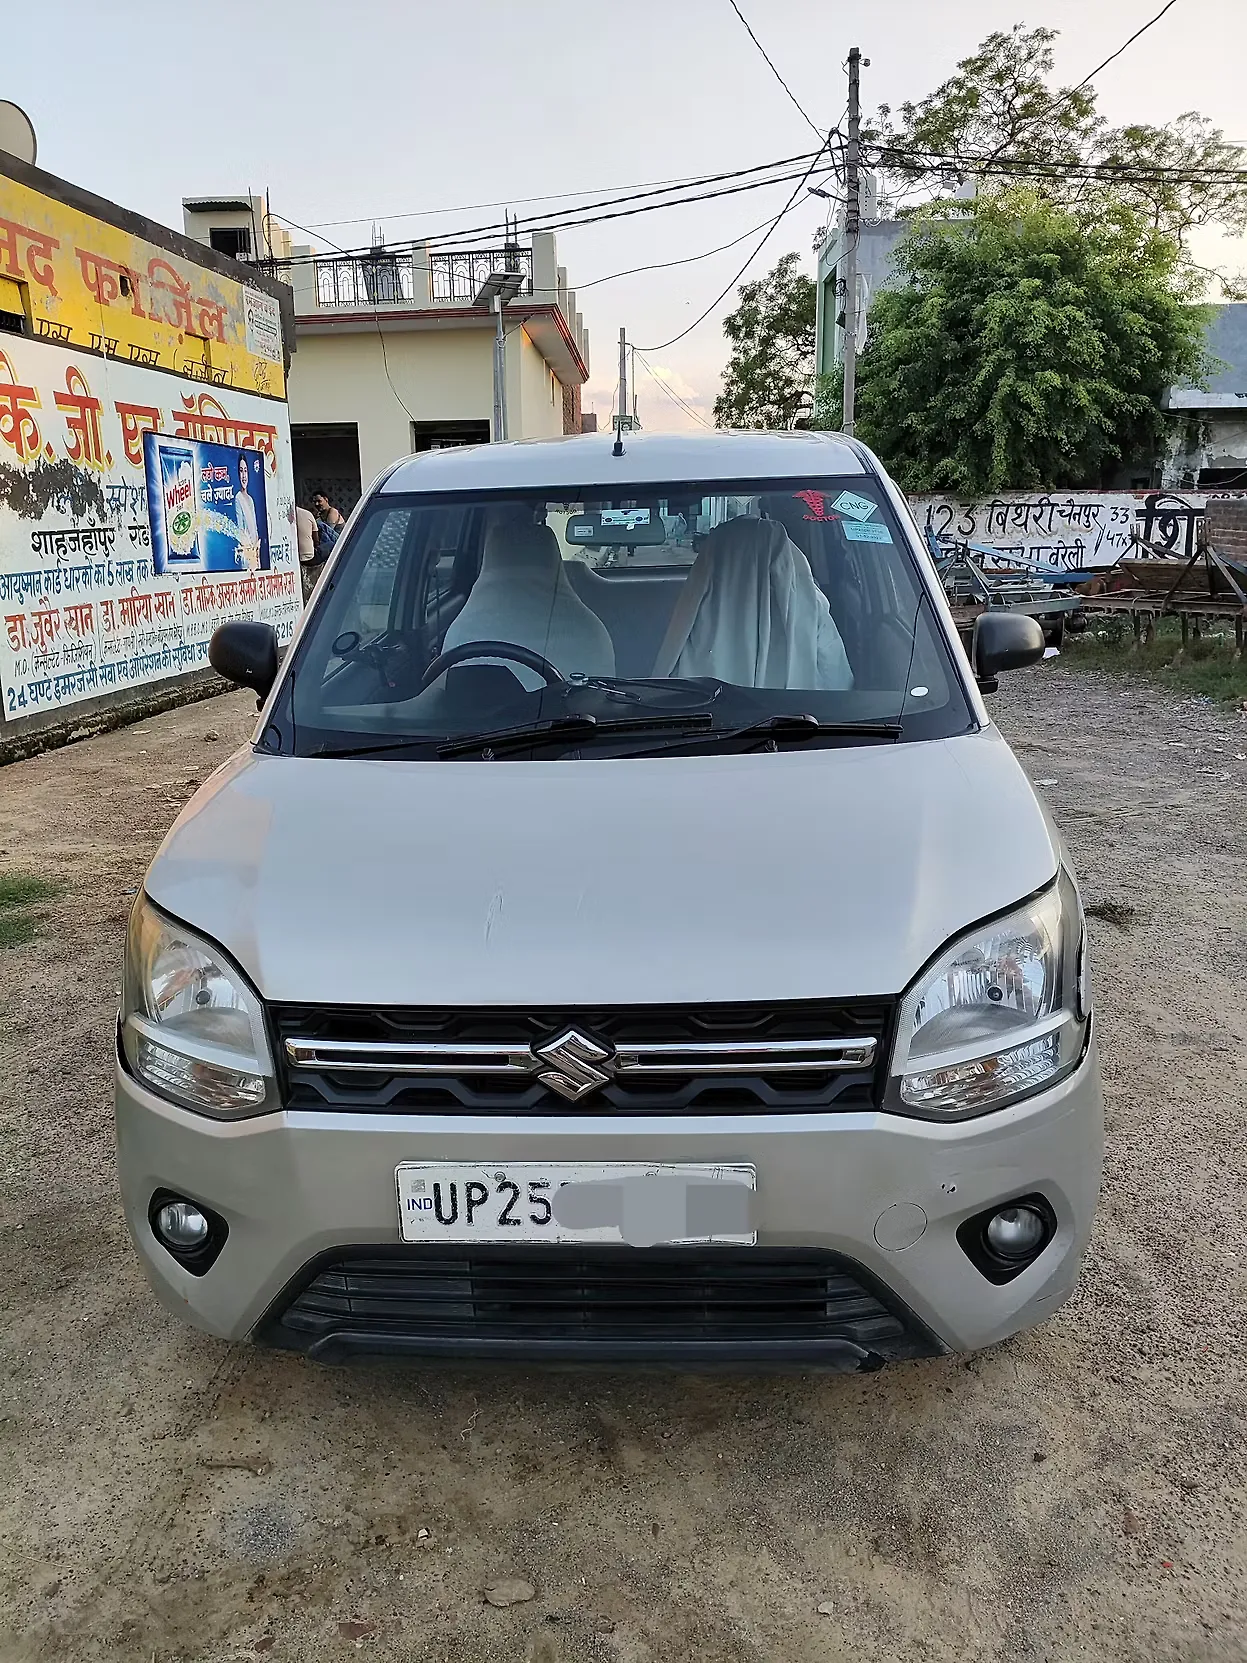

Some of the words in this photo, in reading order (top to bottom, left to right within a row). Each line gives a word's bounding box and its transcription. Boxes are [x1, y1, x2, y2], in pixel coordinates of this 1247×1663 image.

[165, 480, 192, 510] Wheel
[839, 501, 869, 512] CNG
[1110, 506, 1130, 524] 33
[0, 571, 42, 605] आयुष्मान
[106, 560, 114, 586] 5
[115, 560, 135, 586] लाख
[154, 590, 177, 621] खान
[63, 603, 95, 641] खान
[7, 685, 28, 712] 24
[407, 1198, 433, 1212] IND
[432, 1181, 558, 1227] UP25
